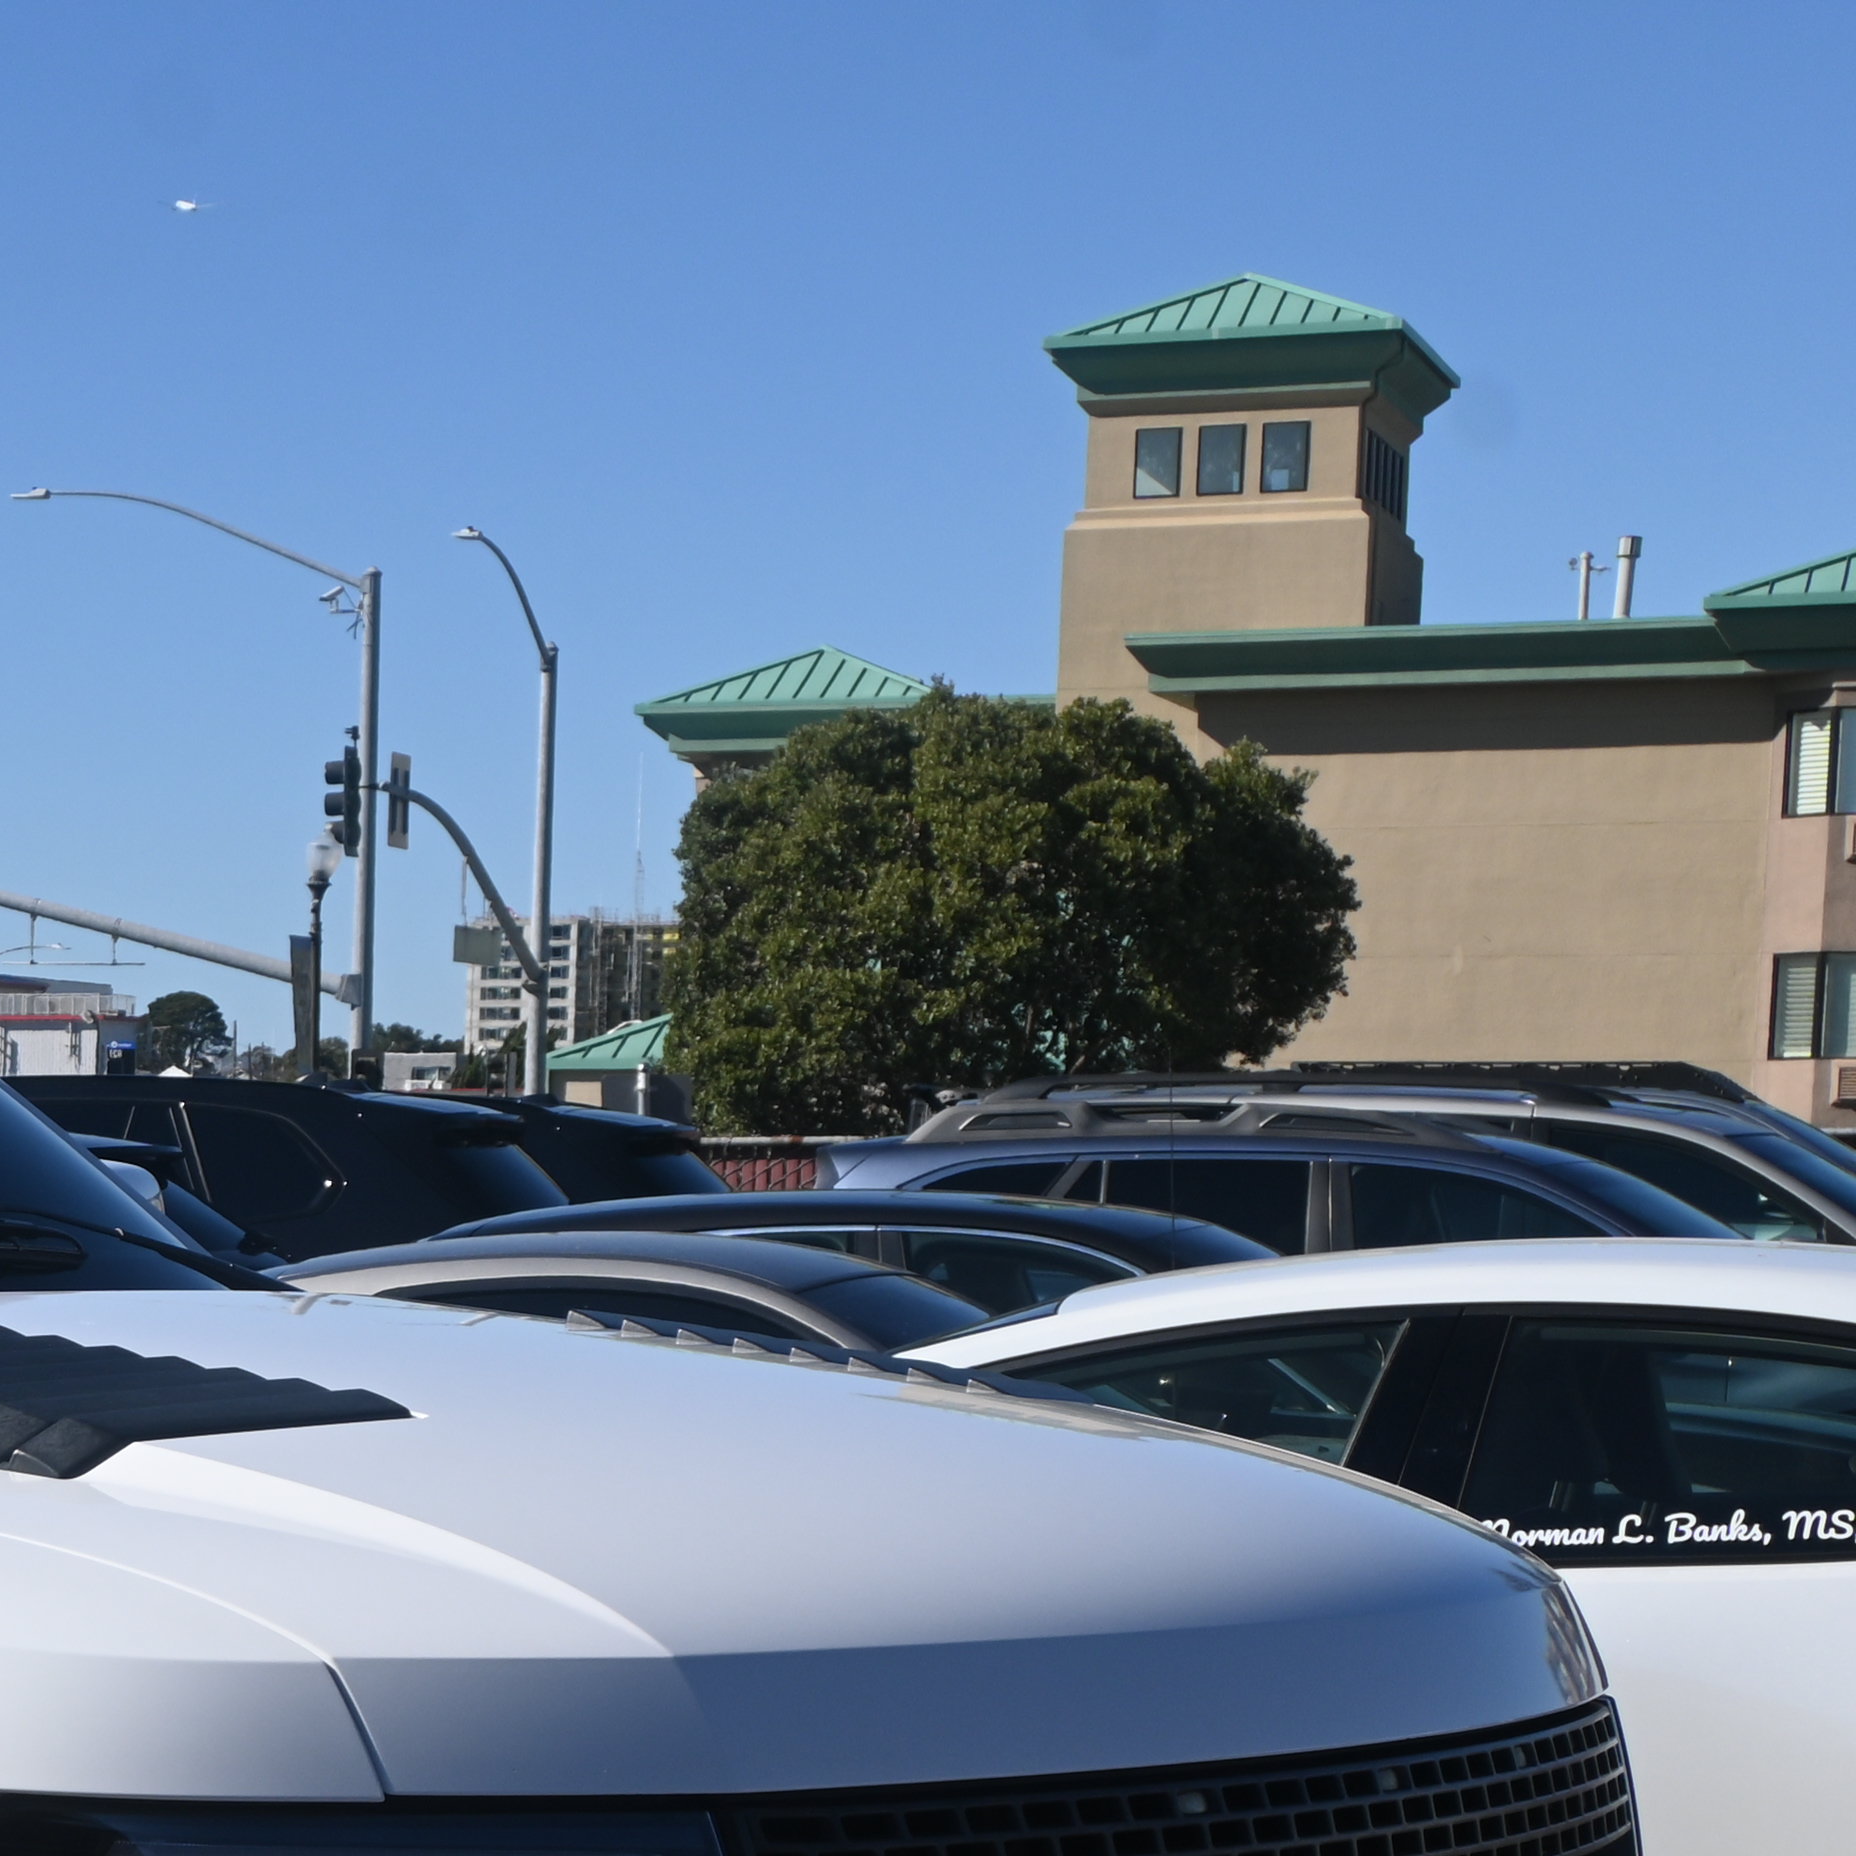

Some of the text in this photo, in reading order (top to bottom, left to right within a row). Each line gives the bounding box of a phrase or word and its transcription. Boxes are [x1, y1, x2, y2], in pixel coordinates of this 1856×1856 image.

[1612, 1514, 1654, 1545] L.
[1664, 1509, 1772, 1546] Banks,
[1781, 1509, 1856, 1543] MS
